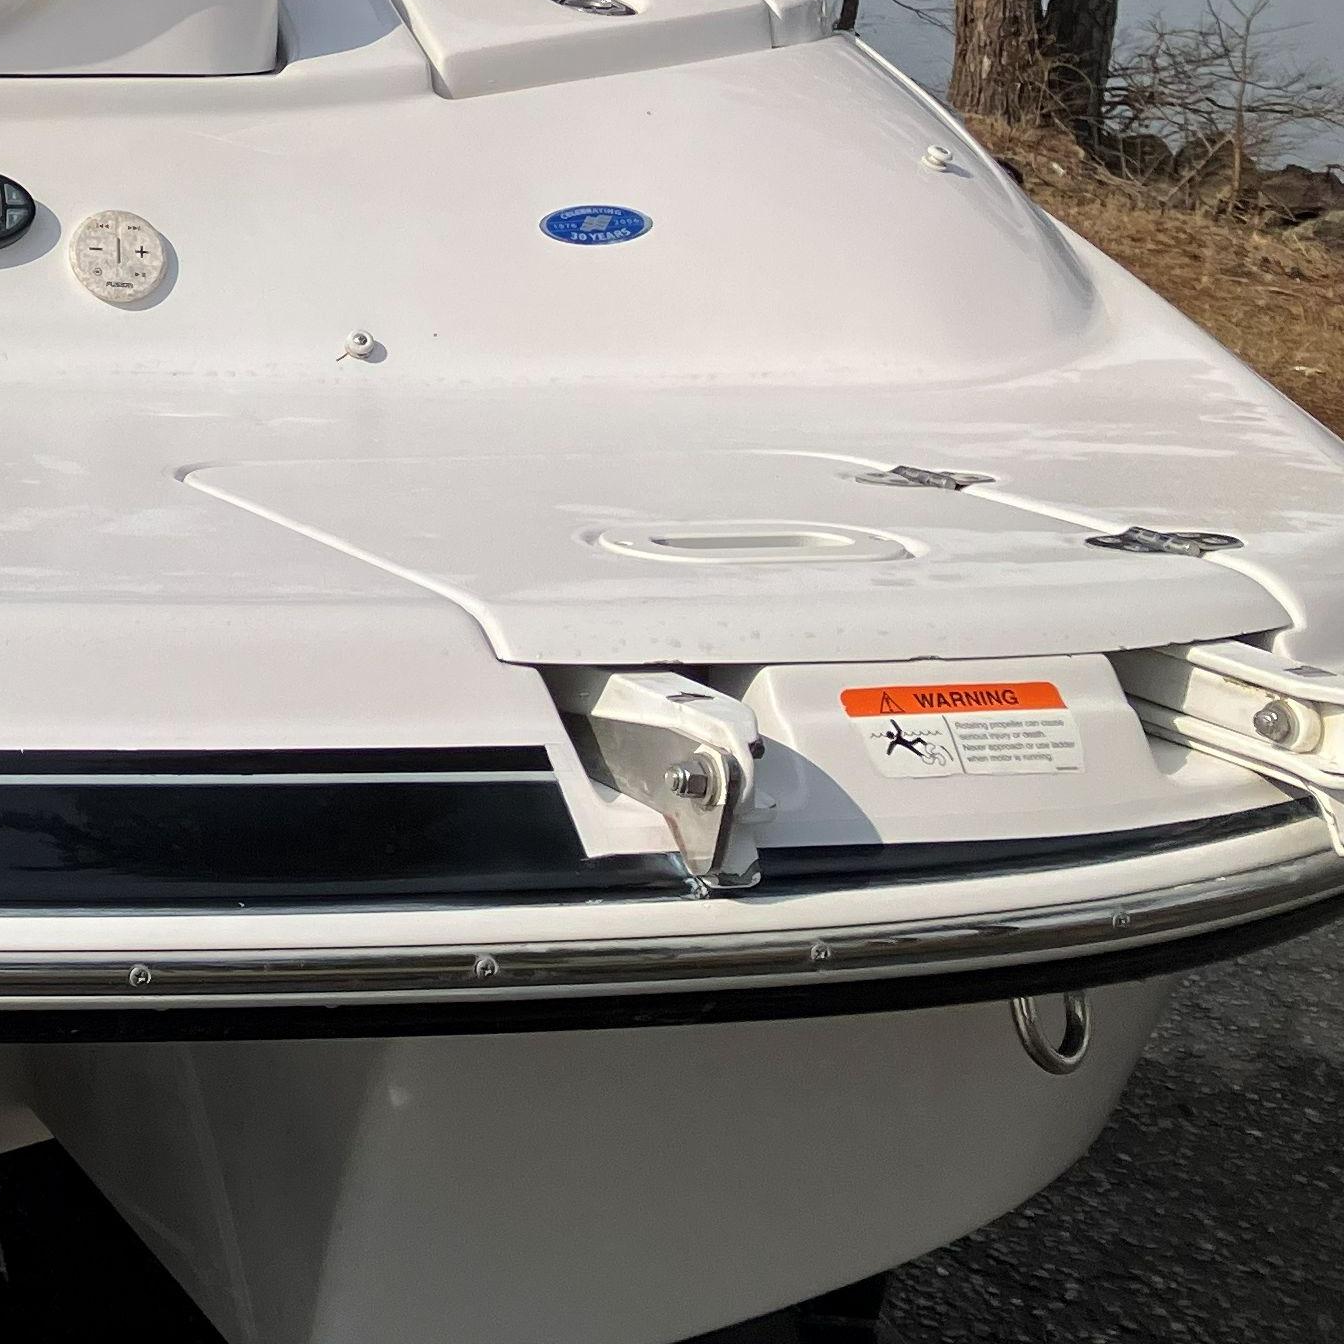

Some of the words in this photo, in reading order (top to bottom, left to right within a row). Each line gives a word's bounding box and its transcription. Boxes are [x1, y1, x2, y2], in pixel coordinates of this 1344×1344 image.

[570, 231, 587, 241] 30
[590, 227, 631, 241] YEARS
[912, 689, 1019, 709] WARNING
